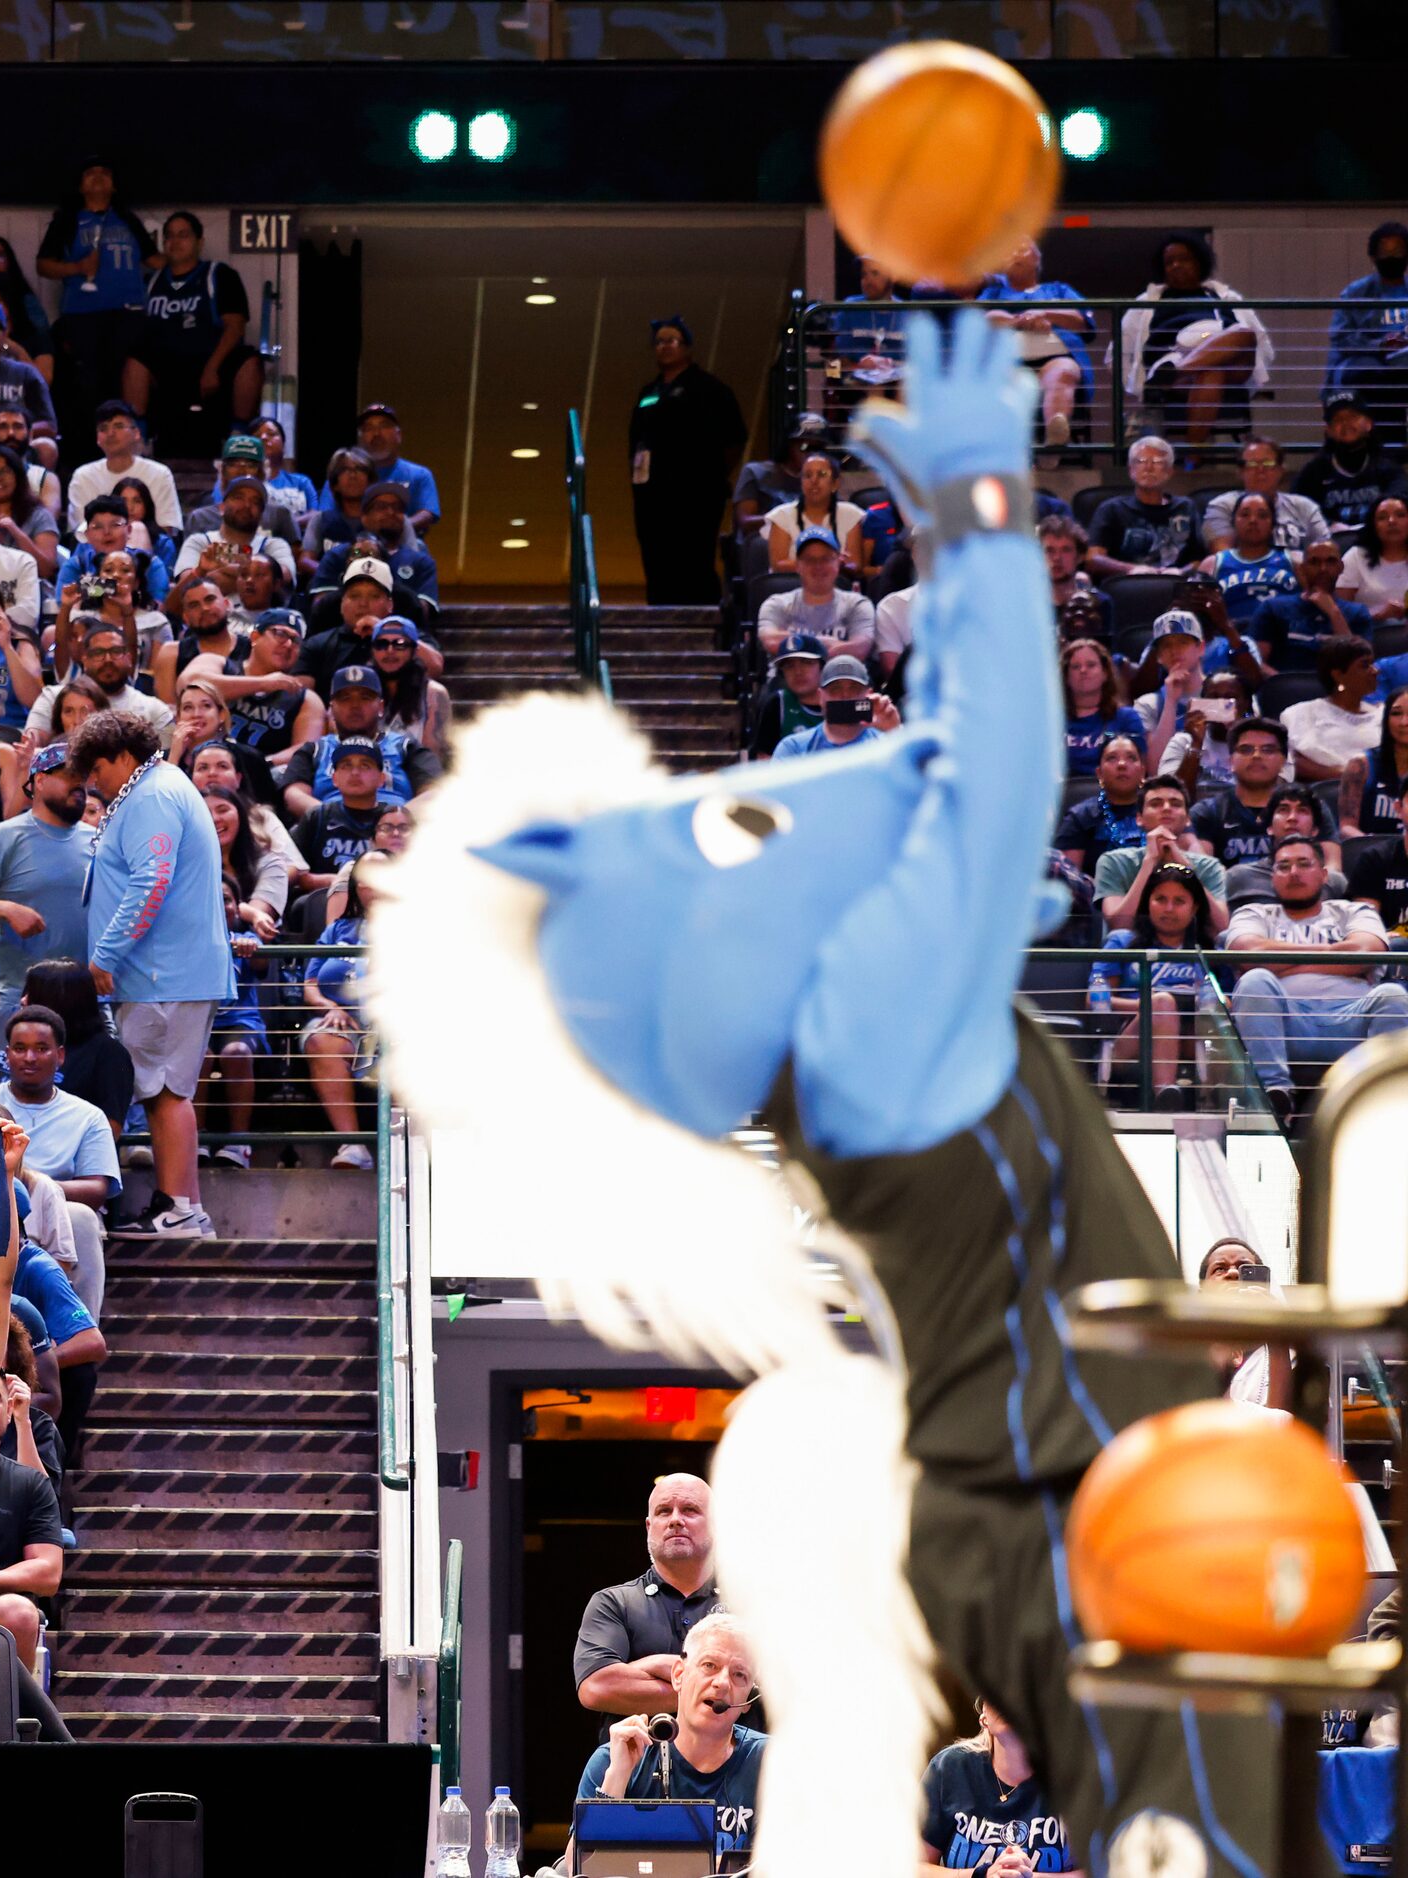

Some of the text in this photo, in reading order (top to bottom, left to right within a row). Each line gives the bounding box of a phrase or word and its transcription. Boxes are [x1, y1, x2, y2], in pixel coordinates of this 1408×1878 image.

[241, 214, 290, 248] EXIT
[148, 295, 201, 318] Mavs
[230, 714, 268, 746] 77
[954, 1812, 1002, 1845] ONE
